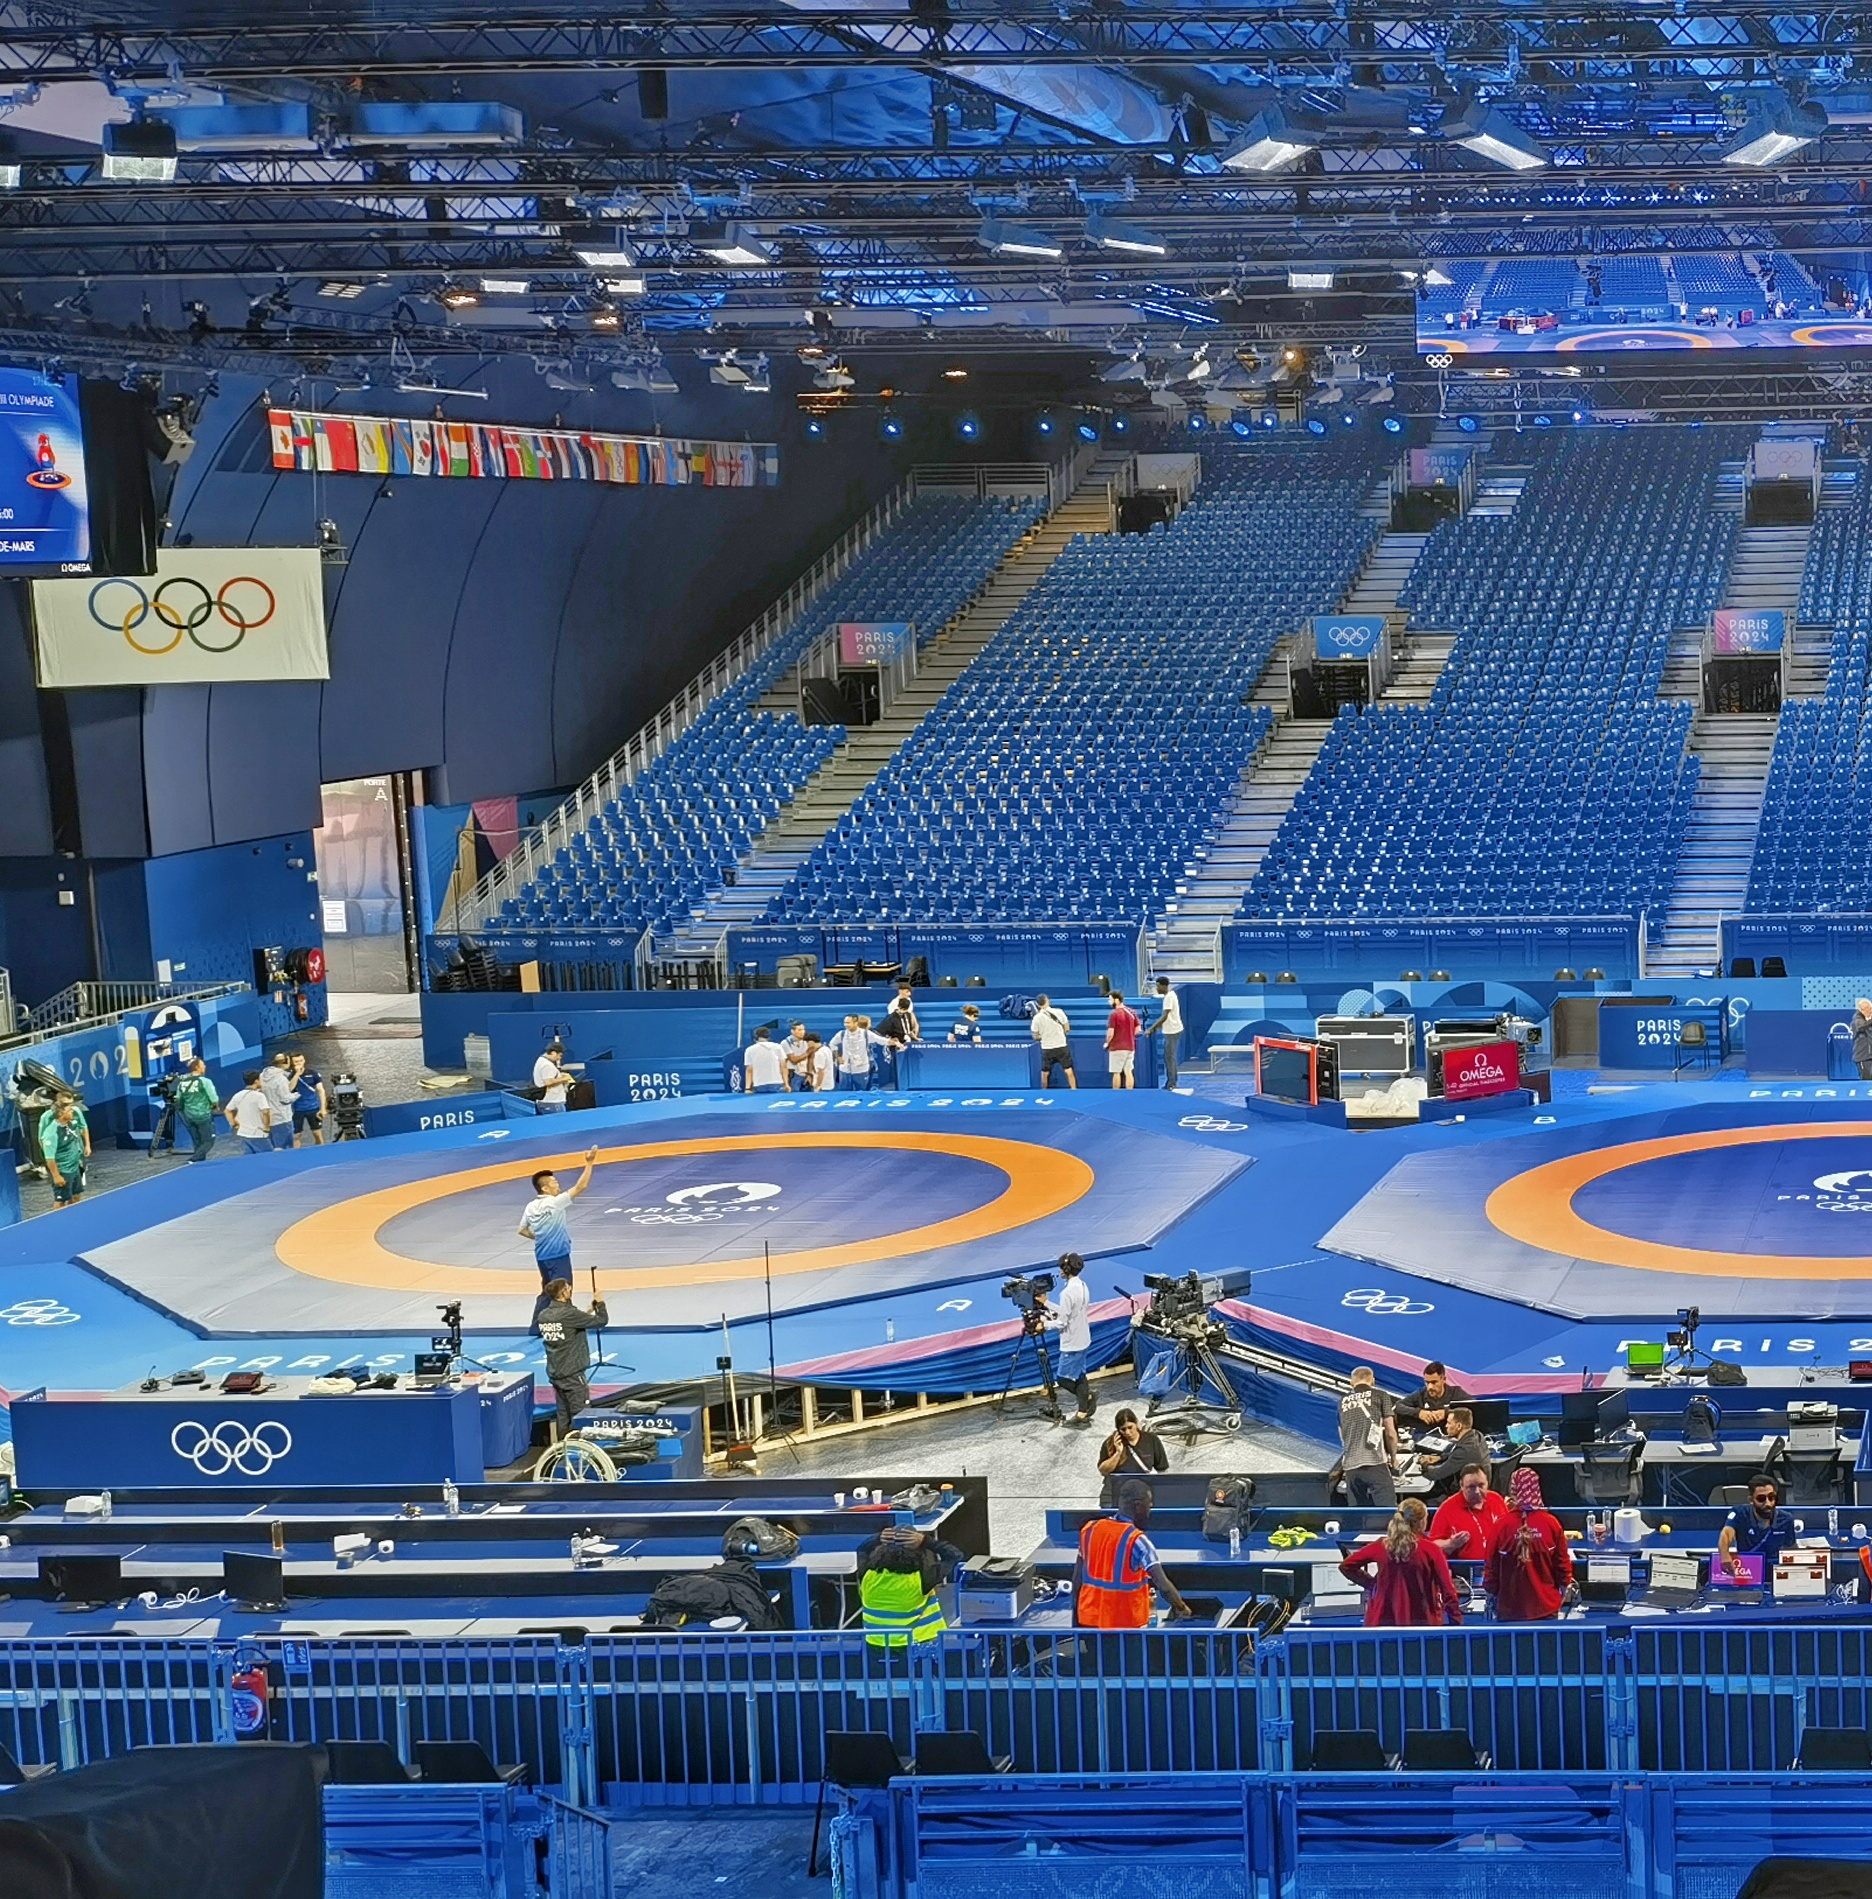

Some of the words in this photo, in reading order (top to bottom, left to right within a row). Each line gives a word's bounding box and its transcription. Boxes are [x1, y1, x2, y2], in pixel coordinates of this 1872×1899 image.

[8, 394, 54, 408] OLYMPIADE
[1423, 455, 1457, 466] PARIS
[68, 563, 92, 573] OMEGA
[1730, 620, 1768, 630] PARIS
[855, 632, 894, 642] PARIS
[1730, 632, 1769, 642] 2024
[374, 787, 388, 800] A
[1636, 1020, 1681, 1032] PARIS
[1638, 1033, 1681, 1046] 2024
[69, 1045, 130, 1087] 202
[629, 1073, 680, 1087] PARIS
[1460, 1066, 1504, 1082] OMEGA
[630, 1088, 681, 1101] 2024
[768, 1098, 911, 1109] PARIS
[927, 1098, 1055, 1109] 2024
[420, 1110, 474, 1130] PARIS
[538, 1322, 563, 1333] PARIS
[541, 1332, 566, 1341] 024
[192, 1353, 405, 1369] PARIS
[1342, 1390, 1372, 1404] PARIS
[636, 1419, 672, 1428] 2024
[1734, 1568, 1752, 1576] EGA
